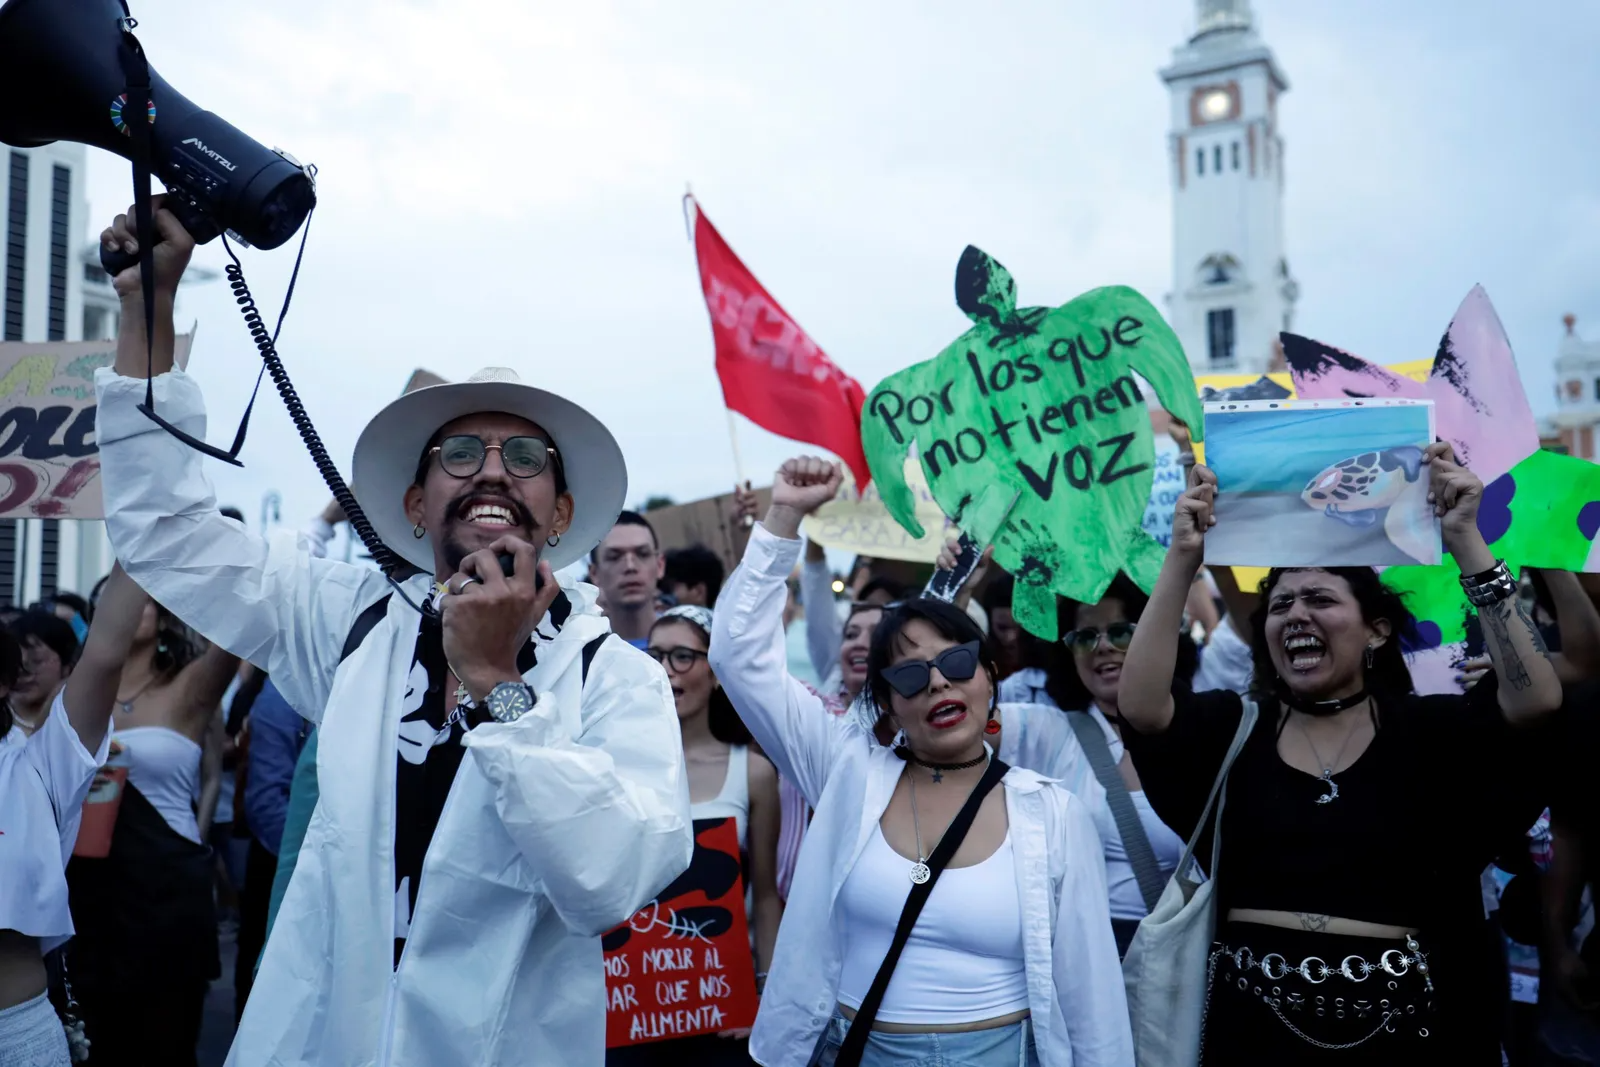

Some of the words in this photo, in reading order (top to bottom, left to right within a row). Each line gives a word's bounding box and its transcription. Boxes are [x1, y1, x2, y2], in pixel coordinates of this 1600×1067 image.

[869, 380, 954, 444] Por
[966, 350, 1043, 397] los
[1047, 315, 1144, 388] que
[922, 427, 987, 477] no
[990, 376, 1145, 451] tienen
[642, 947, 694, 975] MORIR
[704, 946, 724, 970] AL
[654, 978, 690, 1007] QUE
[699, 974, 732, 1001] NOS
[629, 1004, 728, 1040] ALIMENTA
